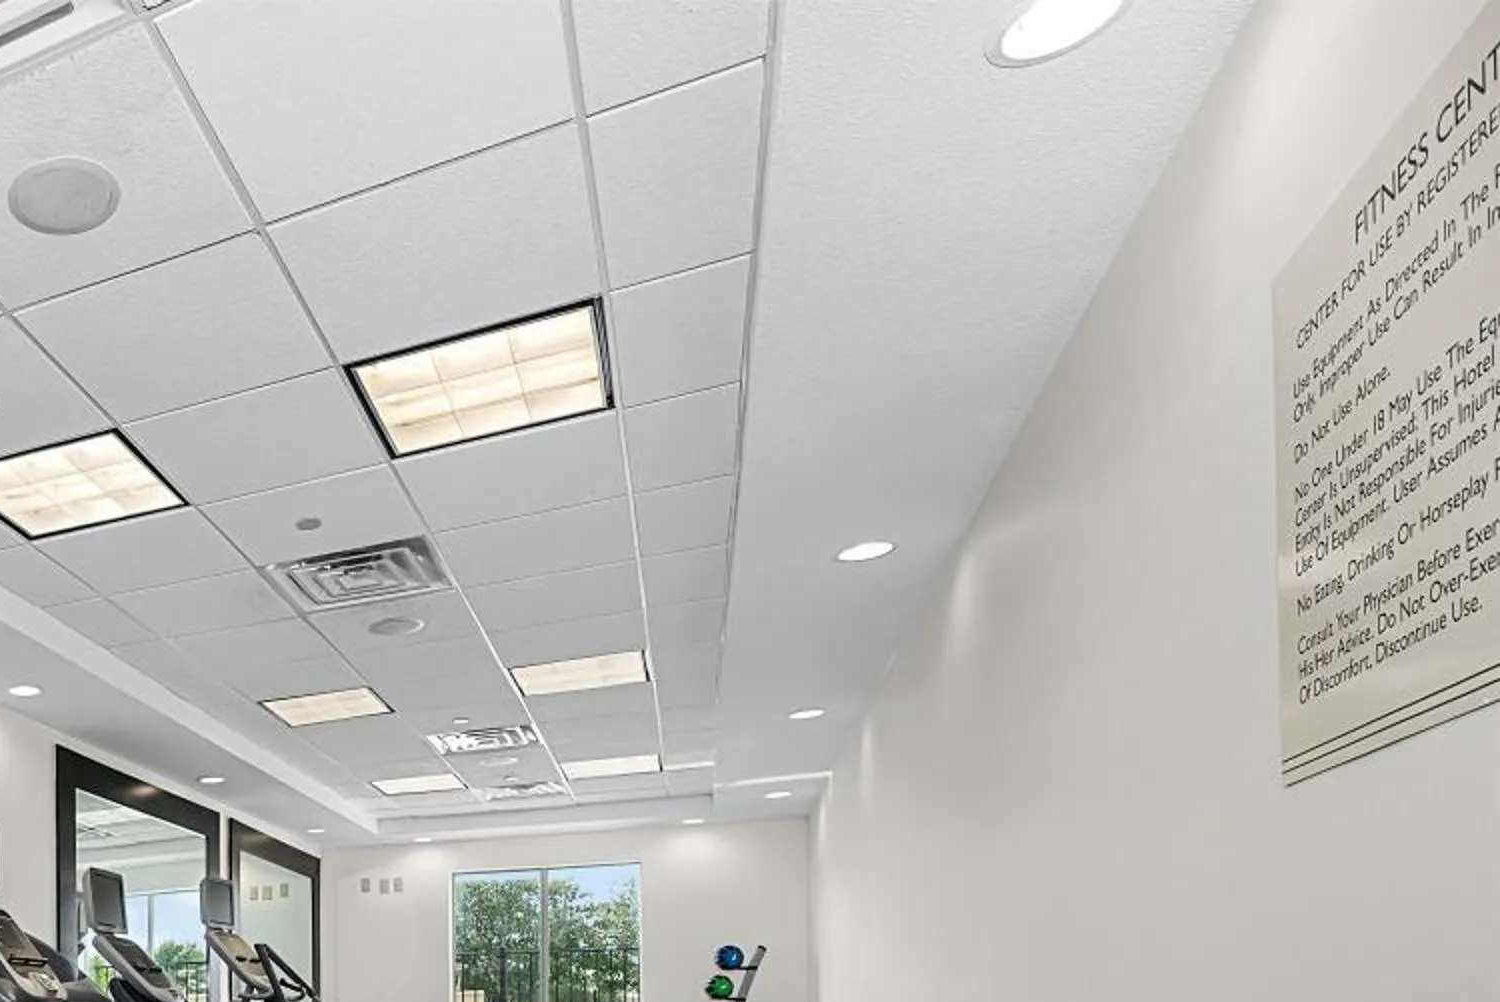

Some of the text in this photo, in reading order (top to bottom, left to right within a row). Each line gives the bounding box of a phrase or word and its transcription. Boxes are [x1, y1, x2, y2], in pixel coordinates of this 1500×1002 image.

[1355, 131, 1429, 245] FITNESS
[1293, 184, 1489, 399] Use Equipment As Directed In The
[1296, 291, 1339, 349] CENTER
[1341, 260, 1366, 300] FOR
[1369, 226, 1393, 267] USE
[1396, 201, 1413, 237] BY
[1319, 341, 1365, 398] Improper
[1368, 317, 1391, 346] Use
[1394, 288, 1419, 320] Can
[1422, 240, 1464, 293] Result
[1468, 224, 1482, 248] In
[1294, 442, 1309, 464] Do
[1311, 419, 1330, 448] Not
[1332, 400, 1353, 426] Use
[1295, 313, 1500, 504] No One Under 18 May Use The Eq
[1295, 491, 1327, 527] Center
[1329, 481, 1338, 500] Is
[1421, 388, 1449, 421] This
[1453, 344, 1495, 397] Hotel
[1323, 512, 1332, 530] Is
[1334, 495, 1355, 523] Not
[1359, 438, 1426, 502] Responsible
[1429, 417, 1454, 446] For
[1295, 555, 1313, 576] Use
[1315, 535, 1329, 561] Of
[1393, 471, 1423, 503] User
[1426, 423, 1488, 480] Assumes
[1297, 595, 1312, 616] No
[1347, 537, 1395, 581] Drinking
[1397, 522, 1416, 545] Or
[1419, 472, 1489, 533] Horseplay
[1298, 620, 1334, 655] Consult
[1335, 604, 1361, 630] Your
[1363, 573, 1413, 615] Physician
[1417, 543, 1461, 582] Before
[1299, 682, 1312, 705] Of
[1375, 613, 1447, 664] Discontinue
[1451, 596, 1483, 623] Use.
[1377, 612, 1397, 635] Do
[1400, 595, 1426, 622] Not
